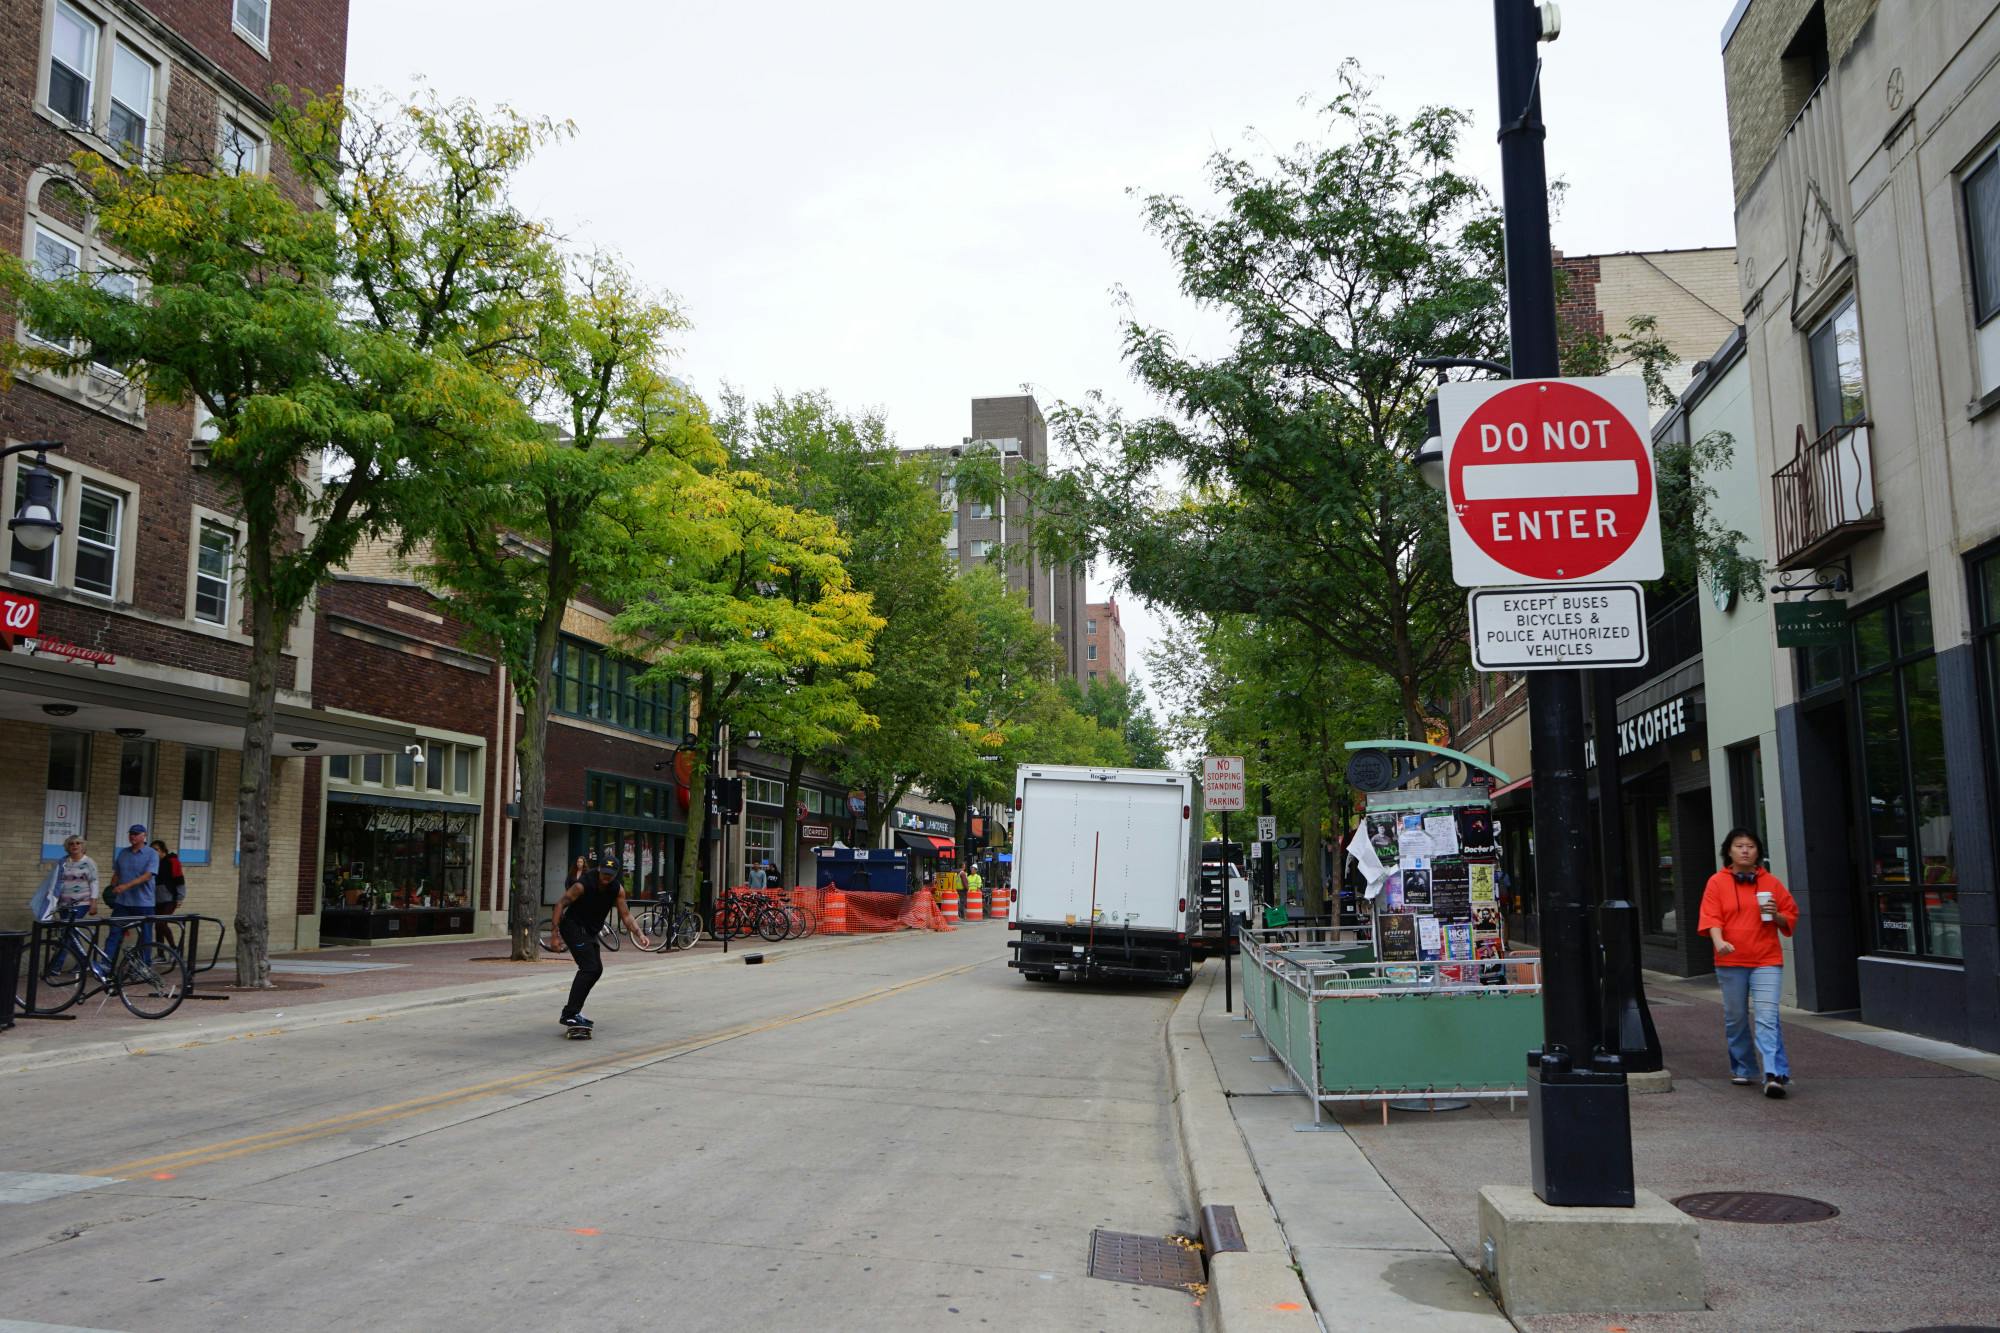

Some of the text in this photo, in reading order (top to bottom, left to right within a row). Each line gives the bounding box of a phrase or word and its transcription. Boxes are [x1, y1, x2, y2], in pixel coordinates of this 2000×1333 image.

[1480, 419, 1611, 453] DO NOT
[1492, 508, 1618, 542] ENTER
[1504, 596, 1609, 612] EXCEPT BUSES
[4, 600, 35, 628] W
[1517, 612, 1600, 627] BICYCLES &
[1487, 626, 1630, 643] POLICE AUTHORIZED
[24, 634, 116, 665] by Walgreens
[1526, 643, 1593, 657] VEHICLES
[1637, 697, 1686, 749] COFFEE
[1217, 760, 1230, 771] NO
[1207, 772, 1241, 781] STOPPING
[1206, 782, 1241, 791] STANDING
[1209, 797, 1240, 806] PARKING
[808, 827, 827, 836] CHIPOTLE
[1261, 829, 1274, 840] 15
[1464, 845, 1489, 853] Doctor
[1448, 928, 1470, 939] HIGH
